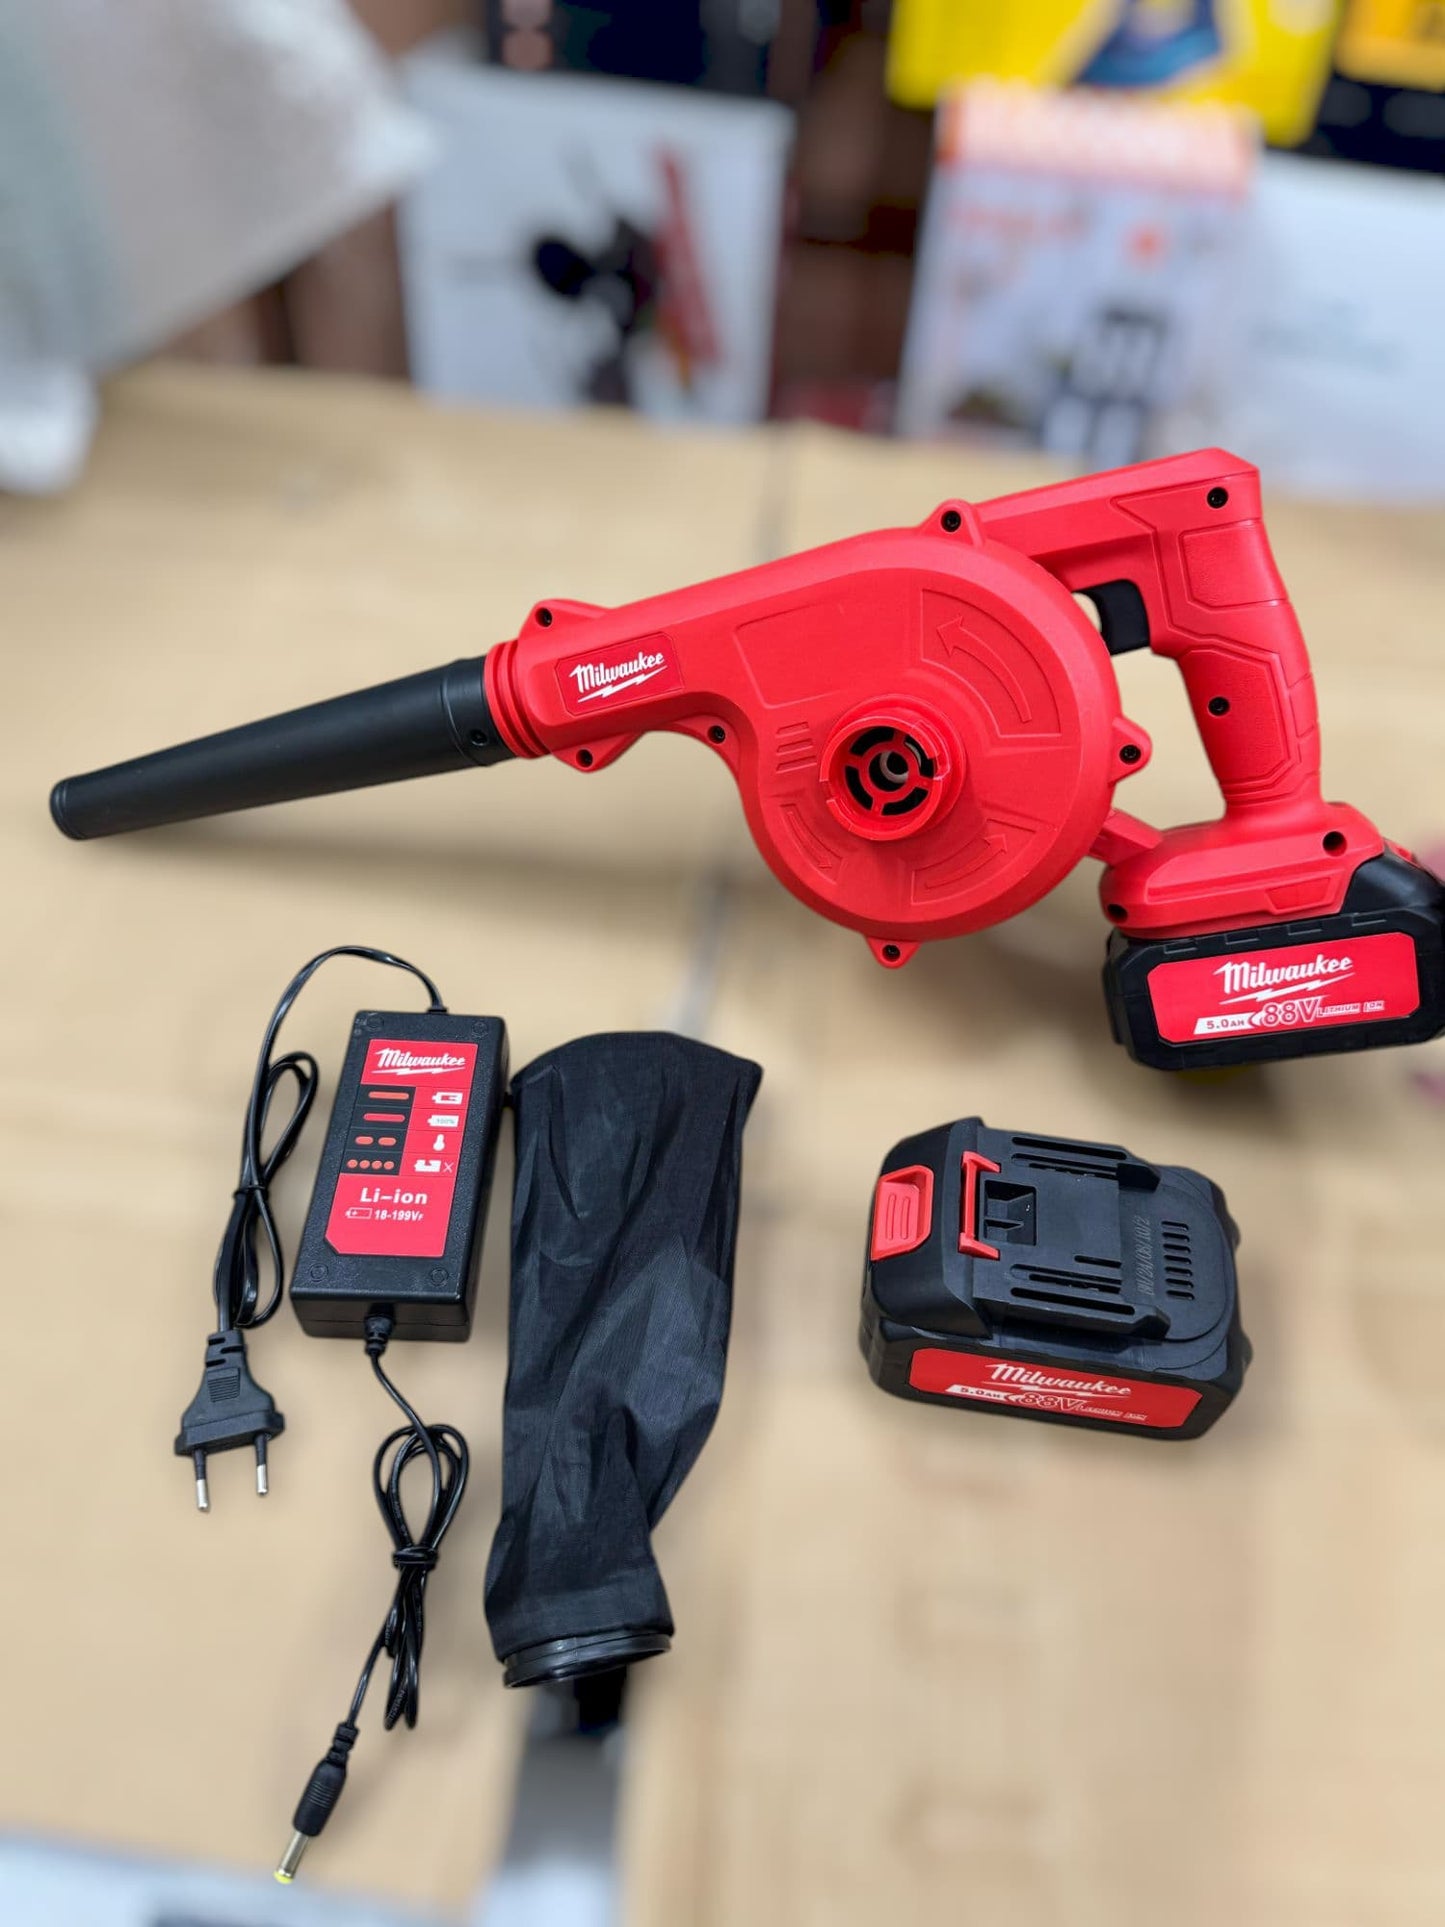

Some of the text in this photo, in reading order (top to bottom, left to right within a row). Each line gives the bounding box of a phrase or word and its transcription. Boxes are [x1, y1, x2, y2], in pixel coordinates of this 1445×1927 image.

[569, 651, 665, 693] Milwaukee
[1213, 954, 1354, 994] Milwaukee
[375, 1047, 466, 1068] Milwaukee
[360, 1187, 428, 1205] Li-ion
[985, 1363, 1132, 1395] Milwaukee
